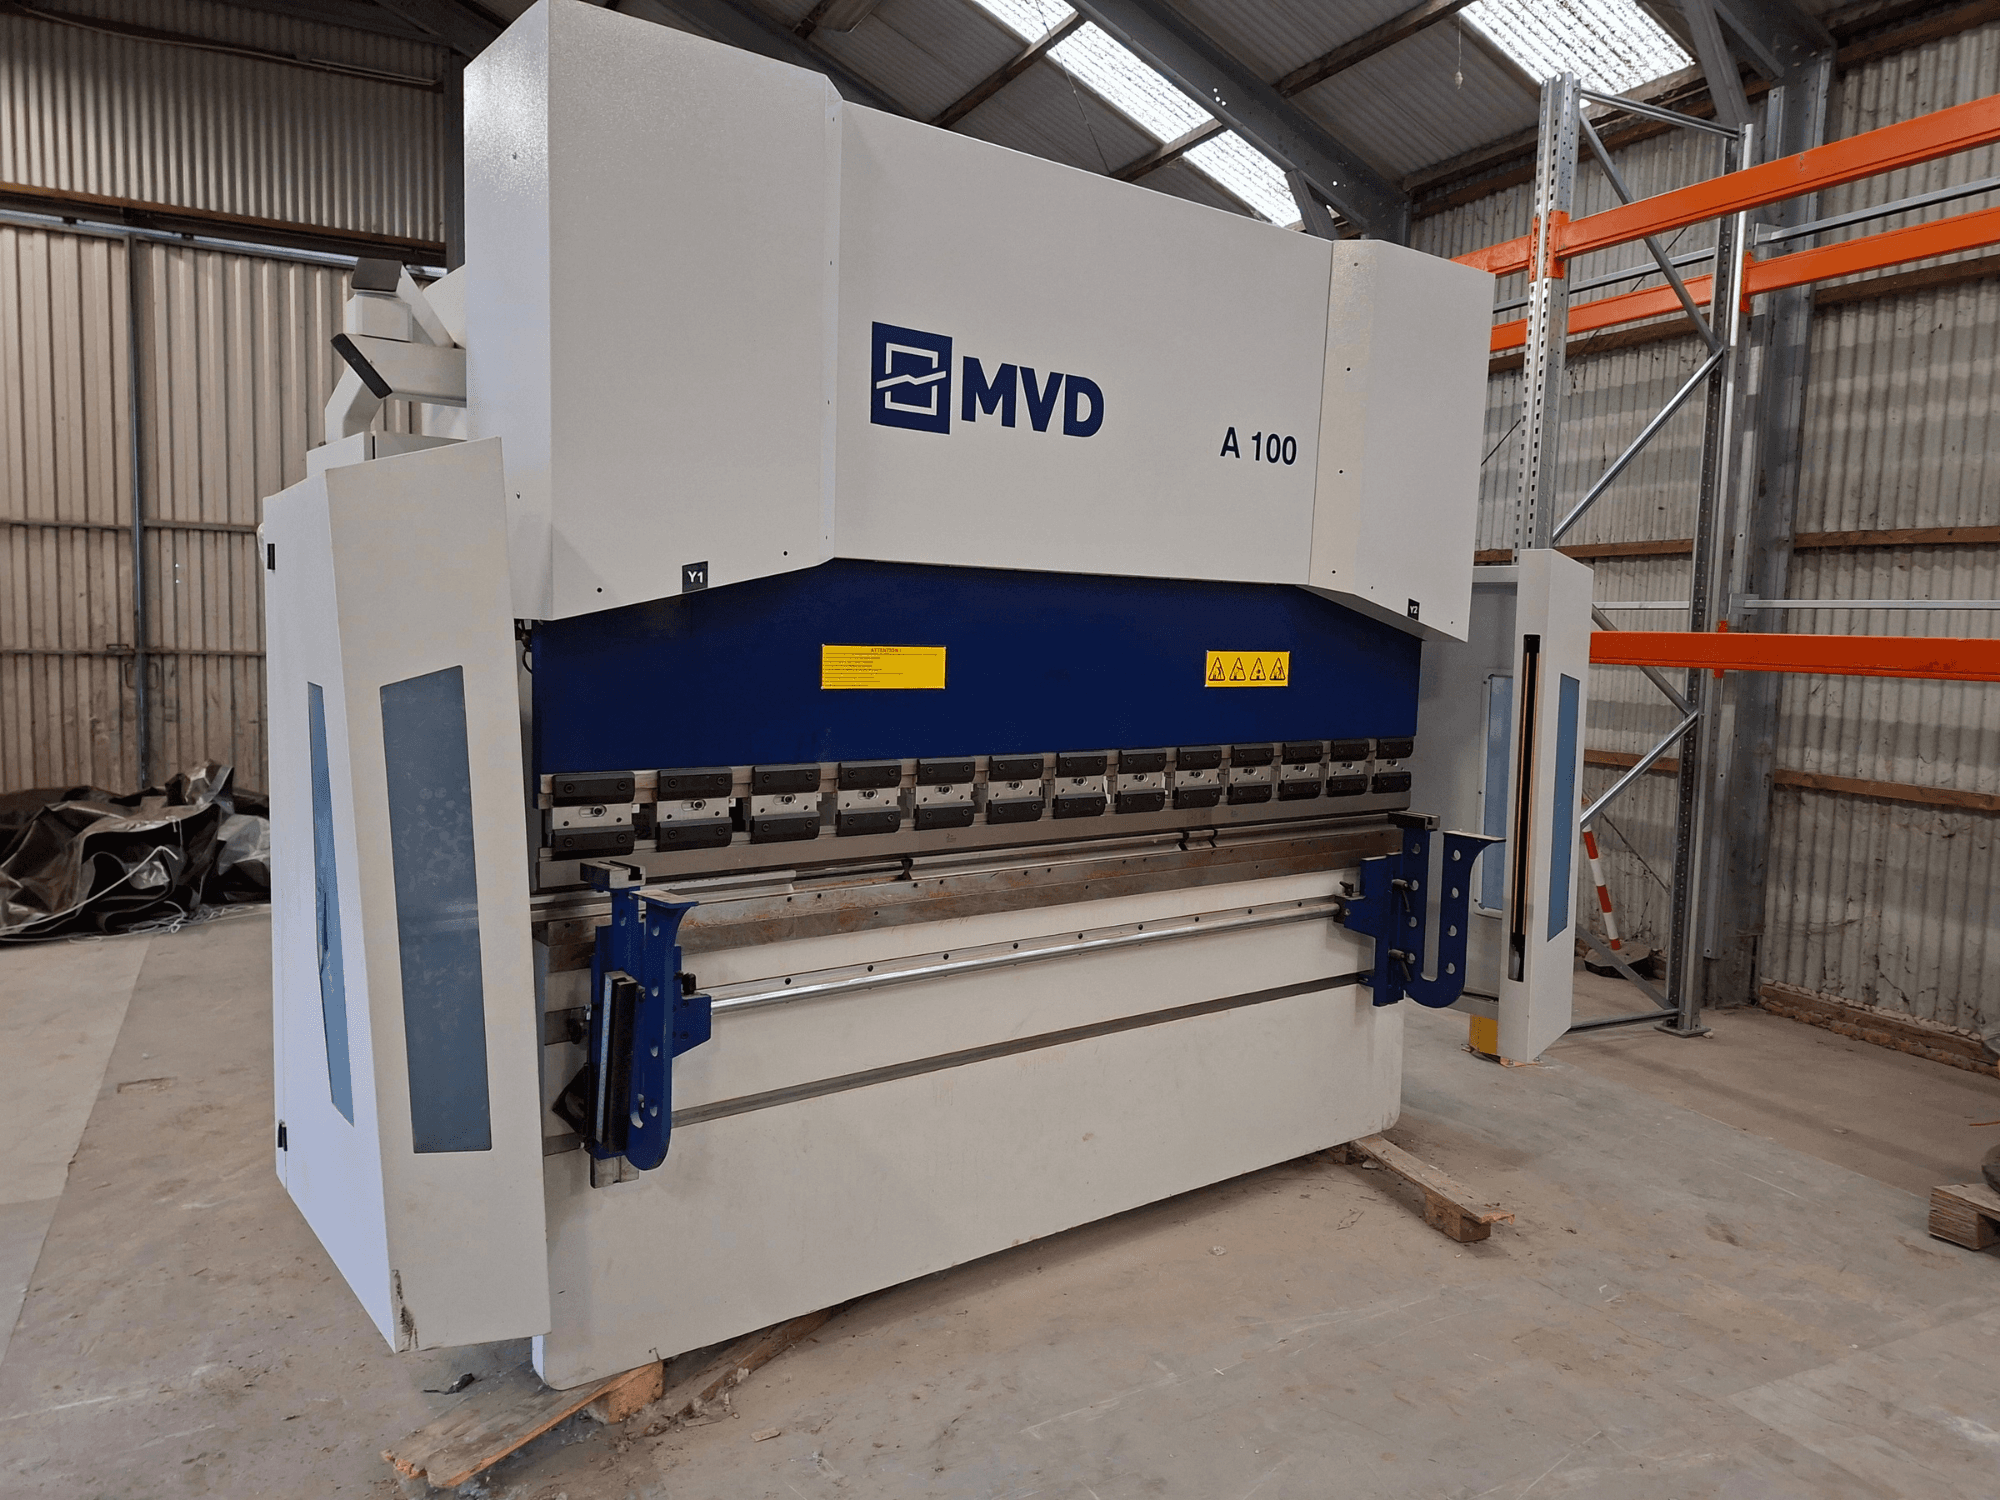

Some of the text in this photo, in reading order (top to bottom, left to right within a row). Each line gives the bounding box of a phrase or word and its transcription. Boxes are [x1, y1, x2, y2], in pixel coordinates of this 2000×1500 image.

[961, 356, 1104, 438] MVD
[1220, 427, 1297, 465] A 100
[687, 570, 703, 584] Y1
[1409, 605, 1419, 615] Y2
